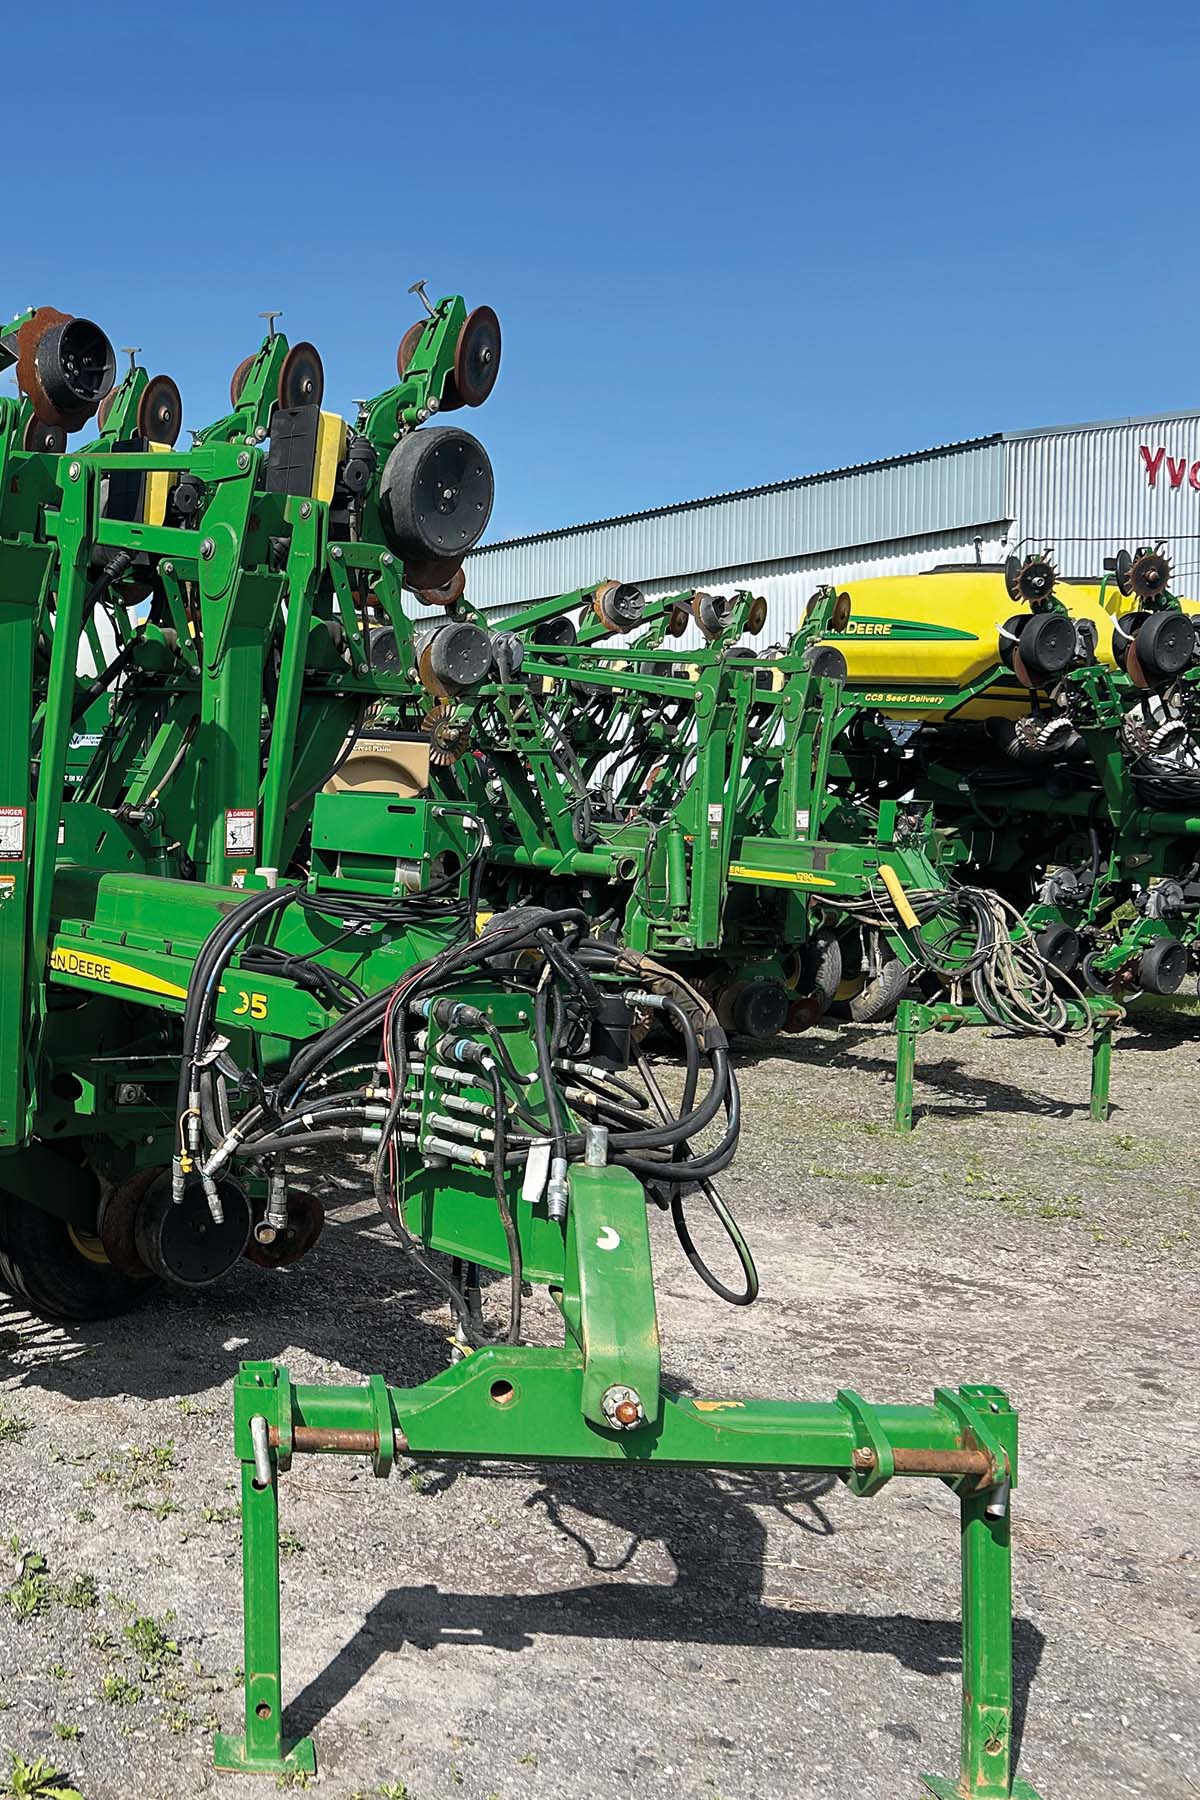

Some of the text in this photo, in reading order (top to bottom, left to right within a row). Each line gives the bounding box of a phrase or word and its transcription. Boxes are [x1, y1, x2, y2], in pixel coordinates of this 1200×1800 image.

[845, 621, 893, 635] DEERE
[864, 693, 945, 705] CCS Seed Delivery
[729, 865, 745, 875] ERE
[49, 953, 112, 980] HN DEERE
